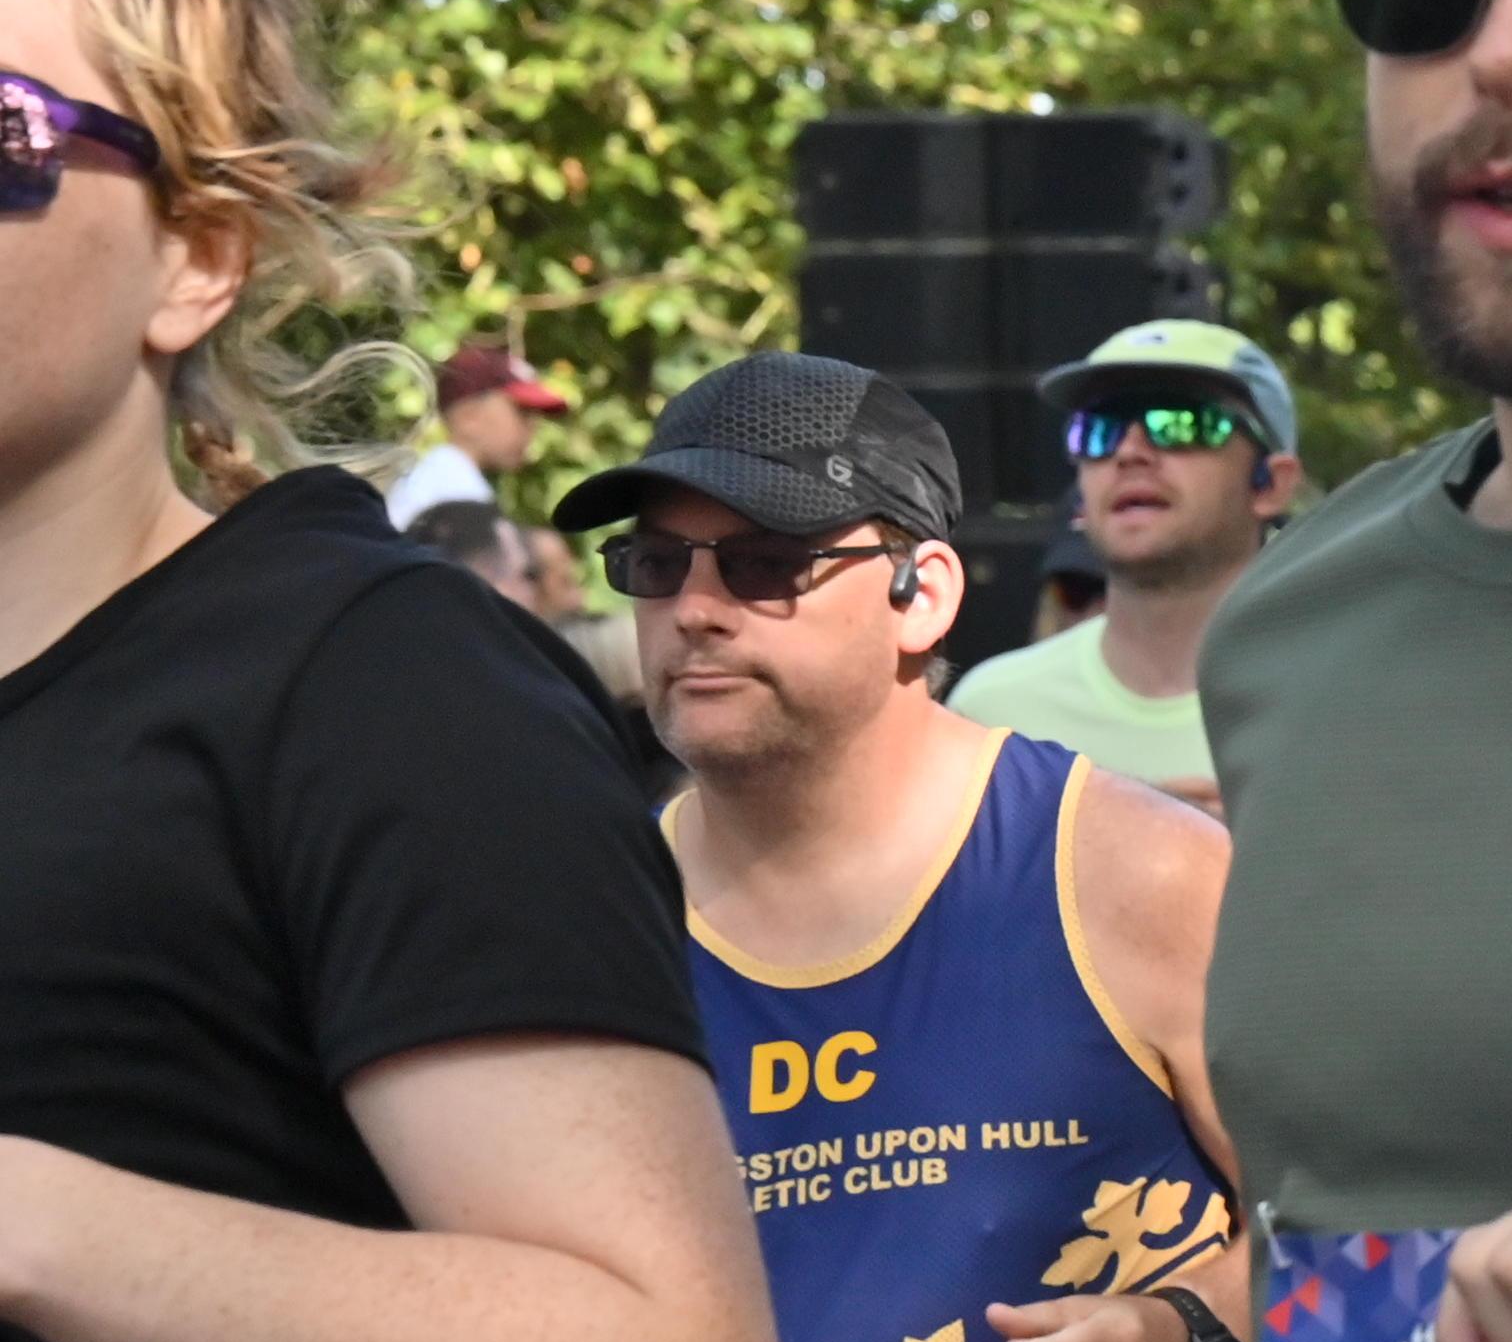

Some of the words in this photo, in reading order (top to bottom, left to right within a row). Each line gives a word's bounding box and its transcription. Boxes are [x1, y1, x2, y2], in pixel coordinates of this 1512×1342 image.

[749, 1030, 878, 1114] DC
[734, 1138, 843, 1183] STON
[856, 1125, 967, 1160] UPON
[981, 1119, 1089, 1149] HULL
[751, 1174, 832, 1214] ETIC
[843, 1158, 948, 1195] CLUB
